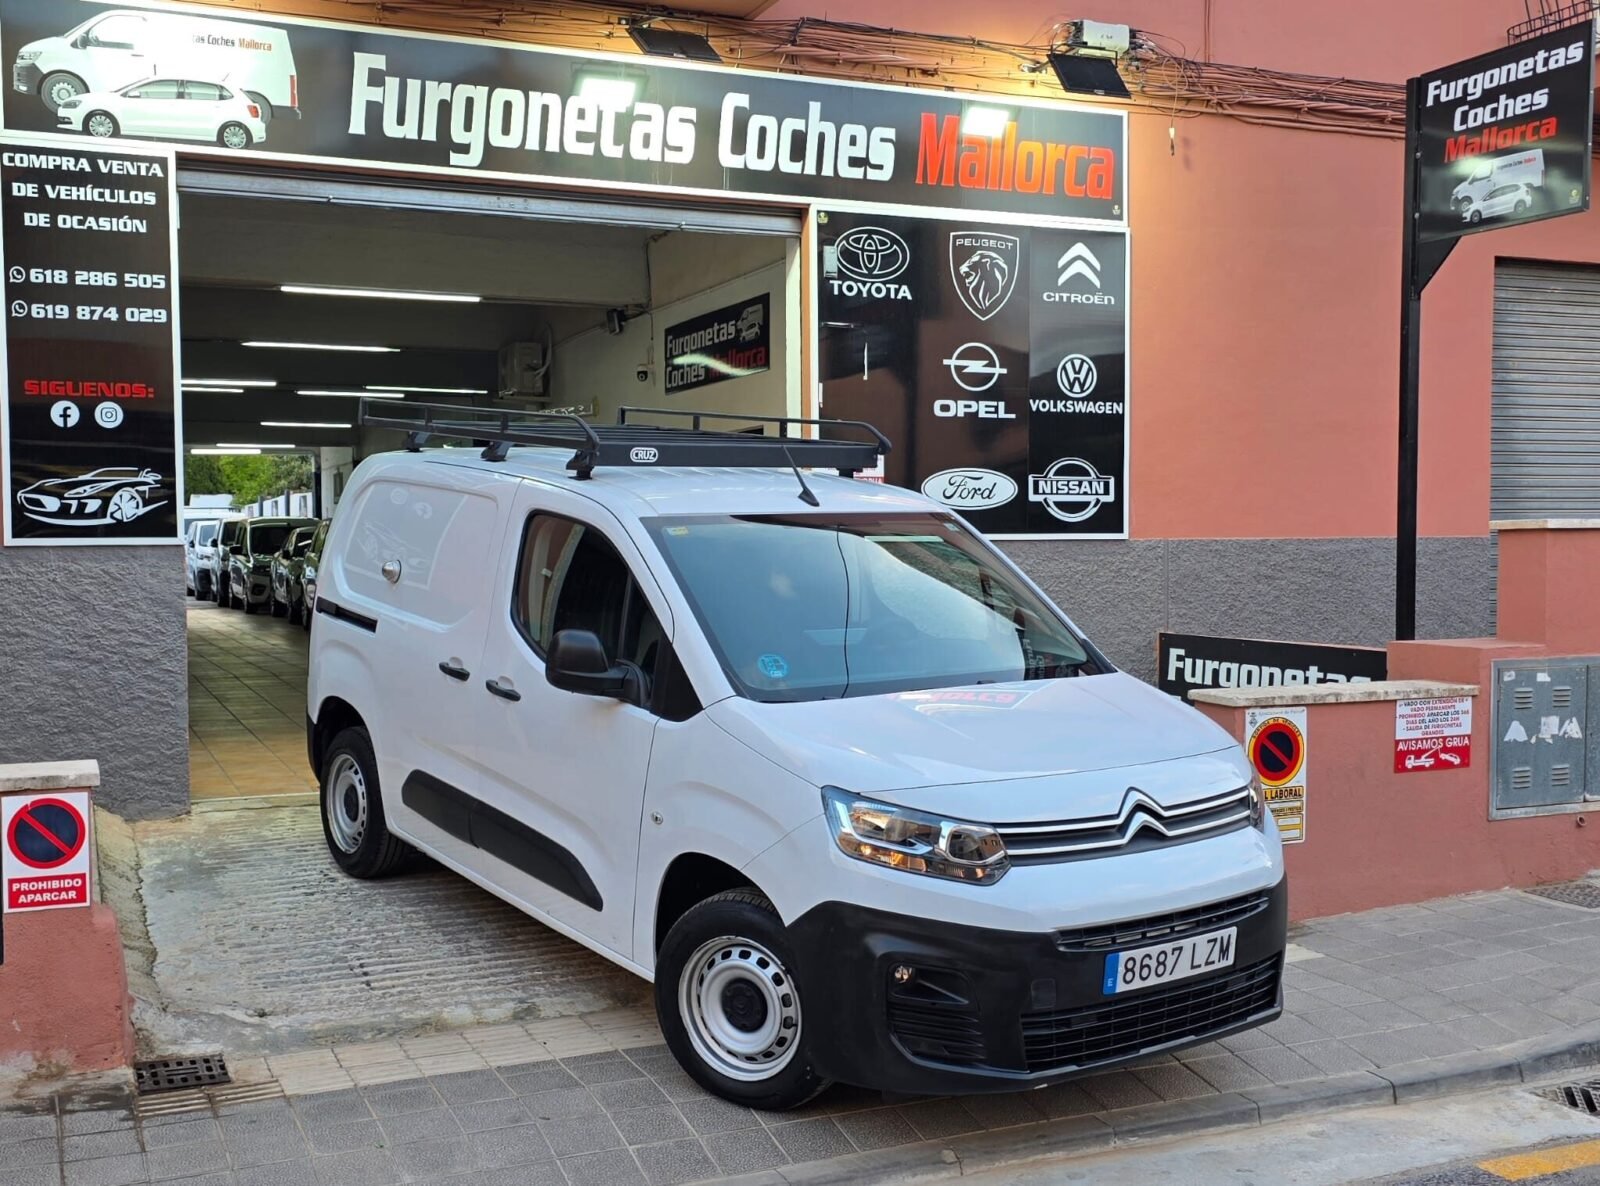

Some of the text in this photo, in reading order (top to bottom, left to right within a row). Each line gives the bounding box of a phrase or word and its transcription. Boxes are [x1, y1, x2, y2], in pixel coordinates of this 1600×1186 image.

[207, 34, 236, 47] Coches
[238, 38, 272, 51] Mallorca
[1426, 41, 1584, 107] Furgonetas
[1453, 88, 1549, 132] Coches
[348, 51, 1116, 199] Furgonetas Coches Mallorca
[1444, 116, 1558, 163] Mallorca
[2, 152, 164, 177] COMPRA VENTA
[12, 182, 156, 205] DE VEHÍCULOS
[24, 212, 147, 233] DE OCASIÓN
[955, 238, 1013, 251] PEUGEOT
[30, 268, 166, 288] 618 286 505
[829, 279, 912, 300] TOYOTA
[31, 304, 167, 323] 619 874 029
[666, 320, 736, 357] Furgonetas
[666, 363, 705, 388] Coches
[24, 379, 154, 398] SIGUENOS:
[933, 399, 1016, 418] OPEL
[1029, 399, 1123, 415] VOLKSWAGEN
[632, 450, 655, 461] CRUZ
[942, 476, 996, 501] Ford
[1038, 481, 1104, 495] NISSAN
[1397, 736, 1469, 751] AVISAMOS GRUA
[1270, 787, 1302, 799] LABORAL
[12, 879, 82, 892] PROHIBIDO
[18, 891, 77, 904] APARCAR
[1122, 934, 1232, 985] 8687 LZM
